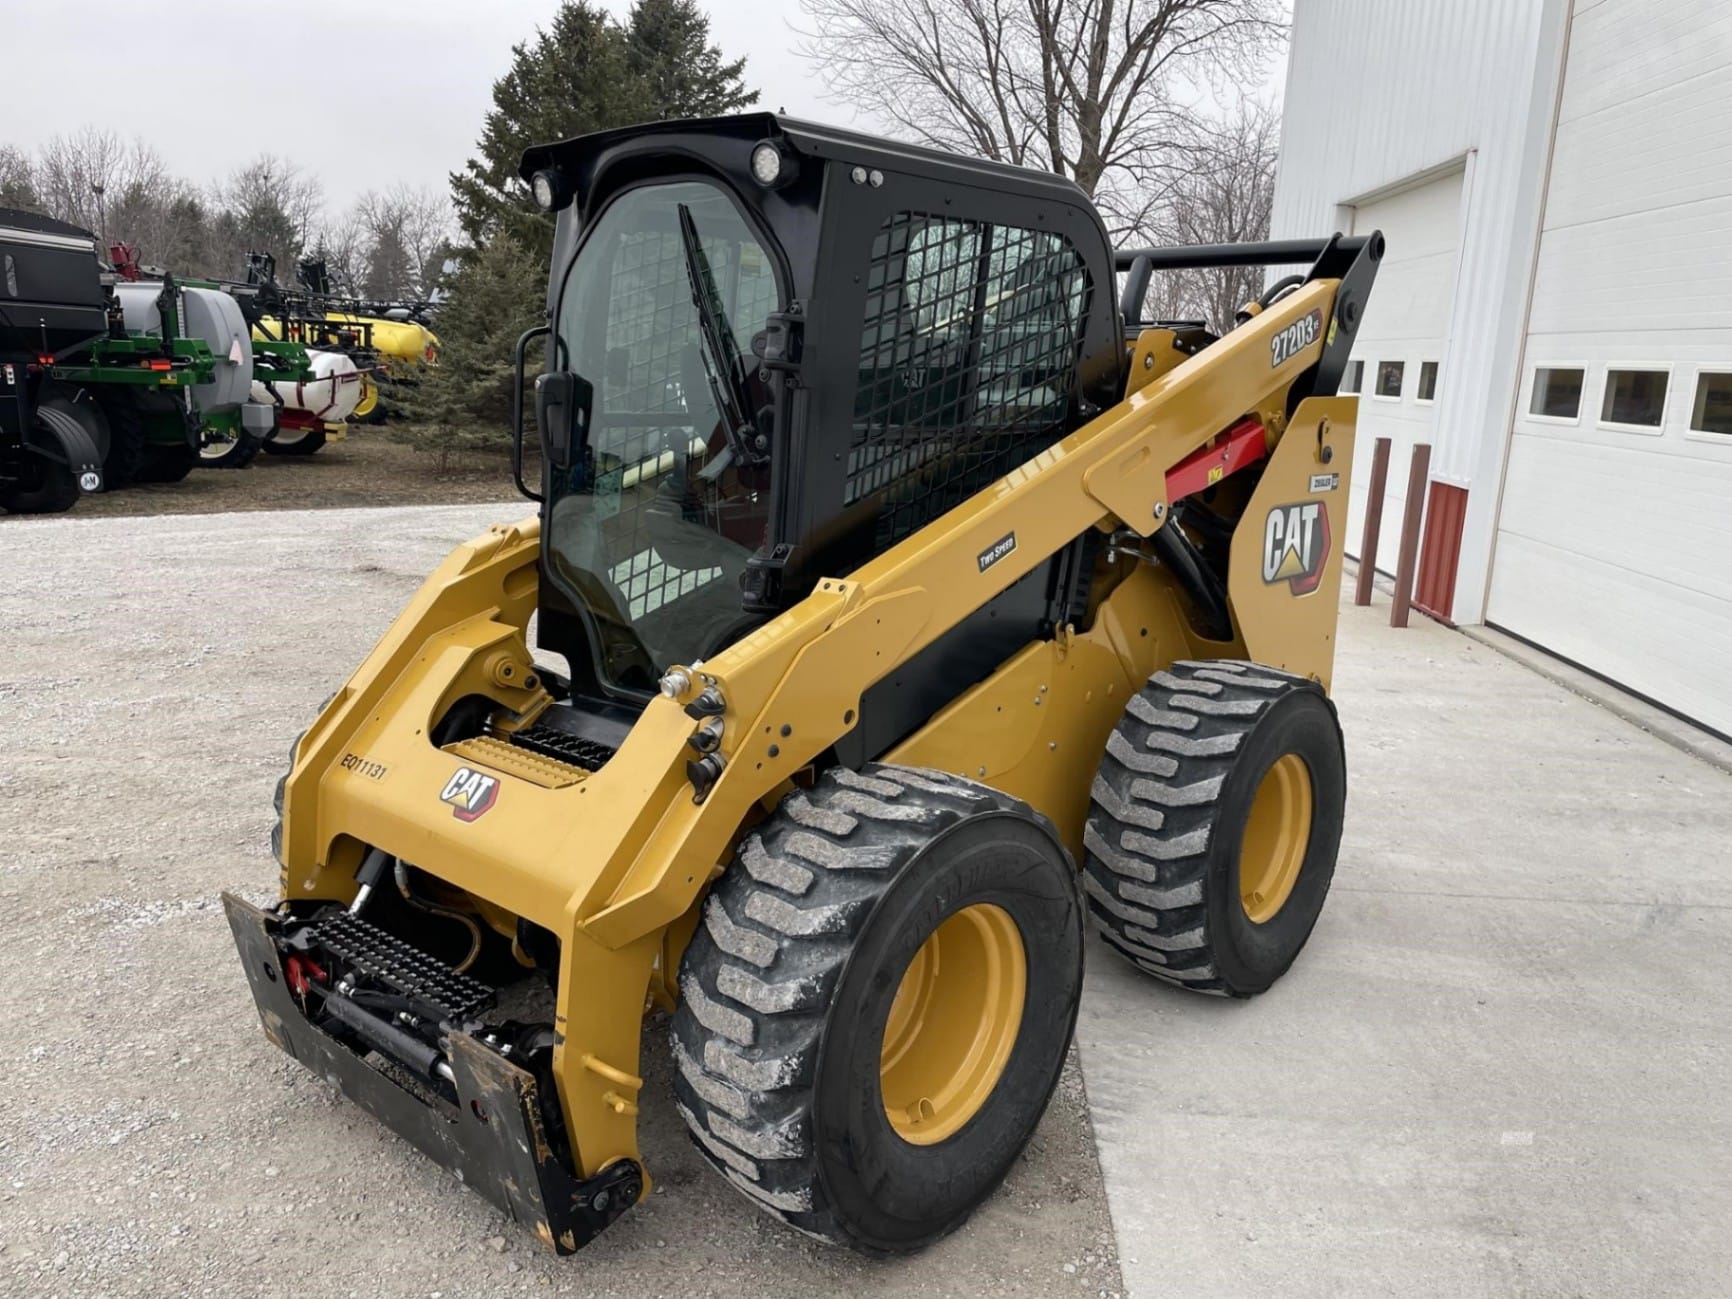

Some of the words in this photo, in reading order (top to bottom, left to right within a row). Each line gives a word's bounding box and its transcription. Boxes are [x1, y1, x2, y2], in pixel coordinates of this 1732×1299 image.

[1271, 315, 1314, 367] 272D3
[1263, 503, 1319, 582] CAT
[340, 753, 388, 780] EQ11131
[441, 767, 496, 810] CAT
